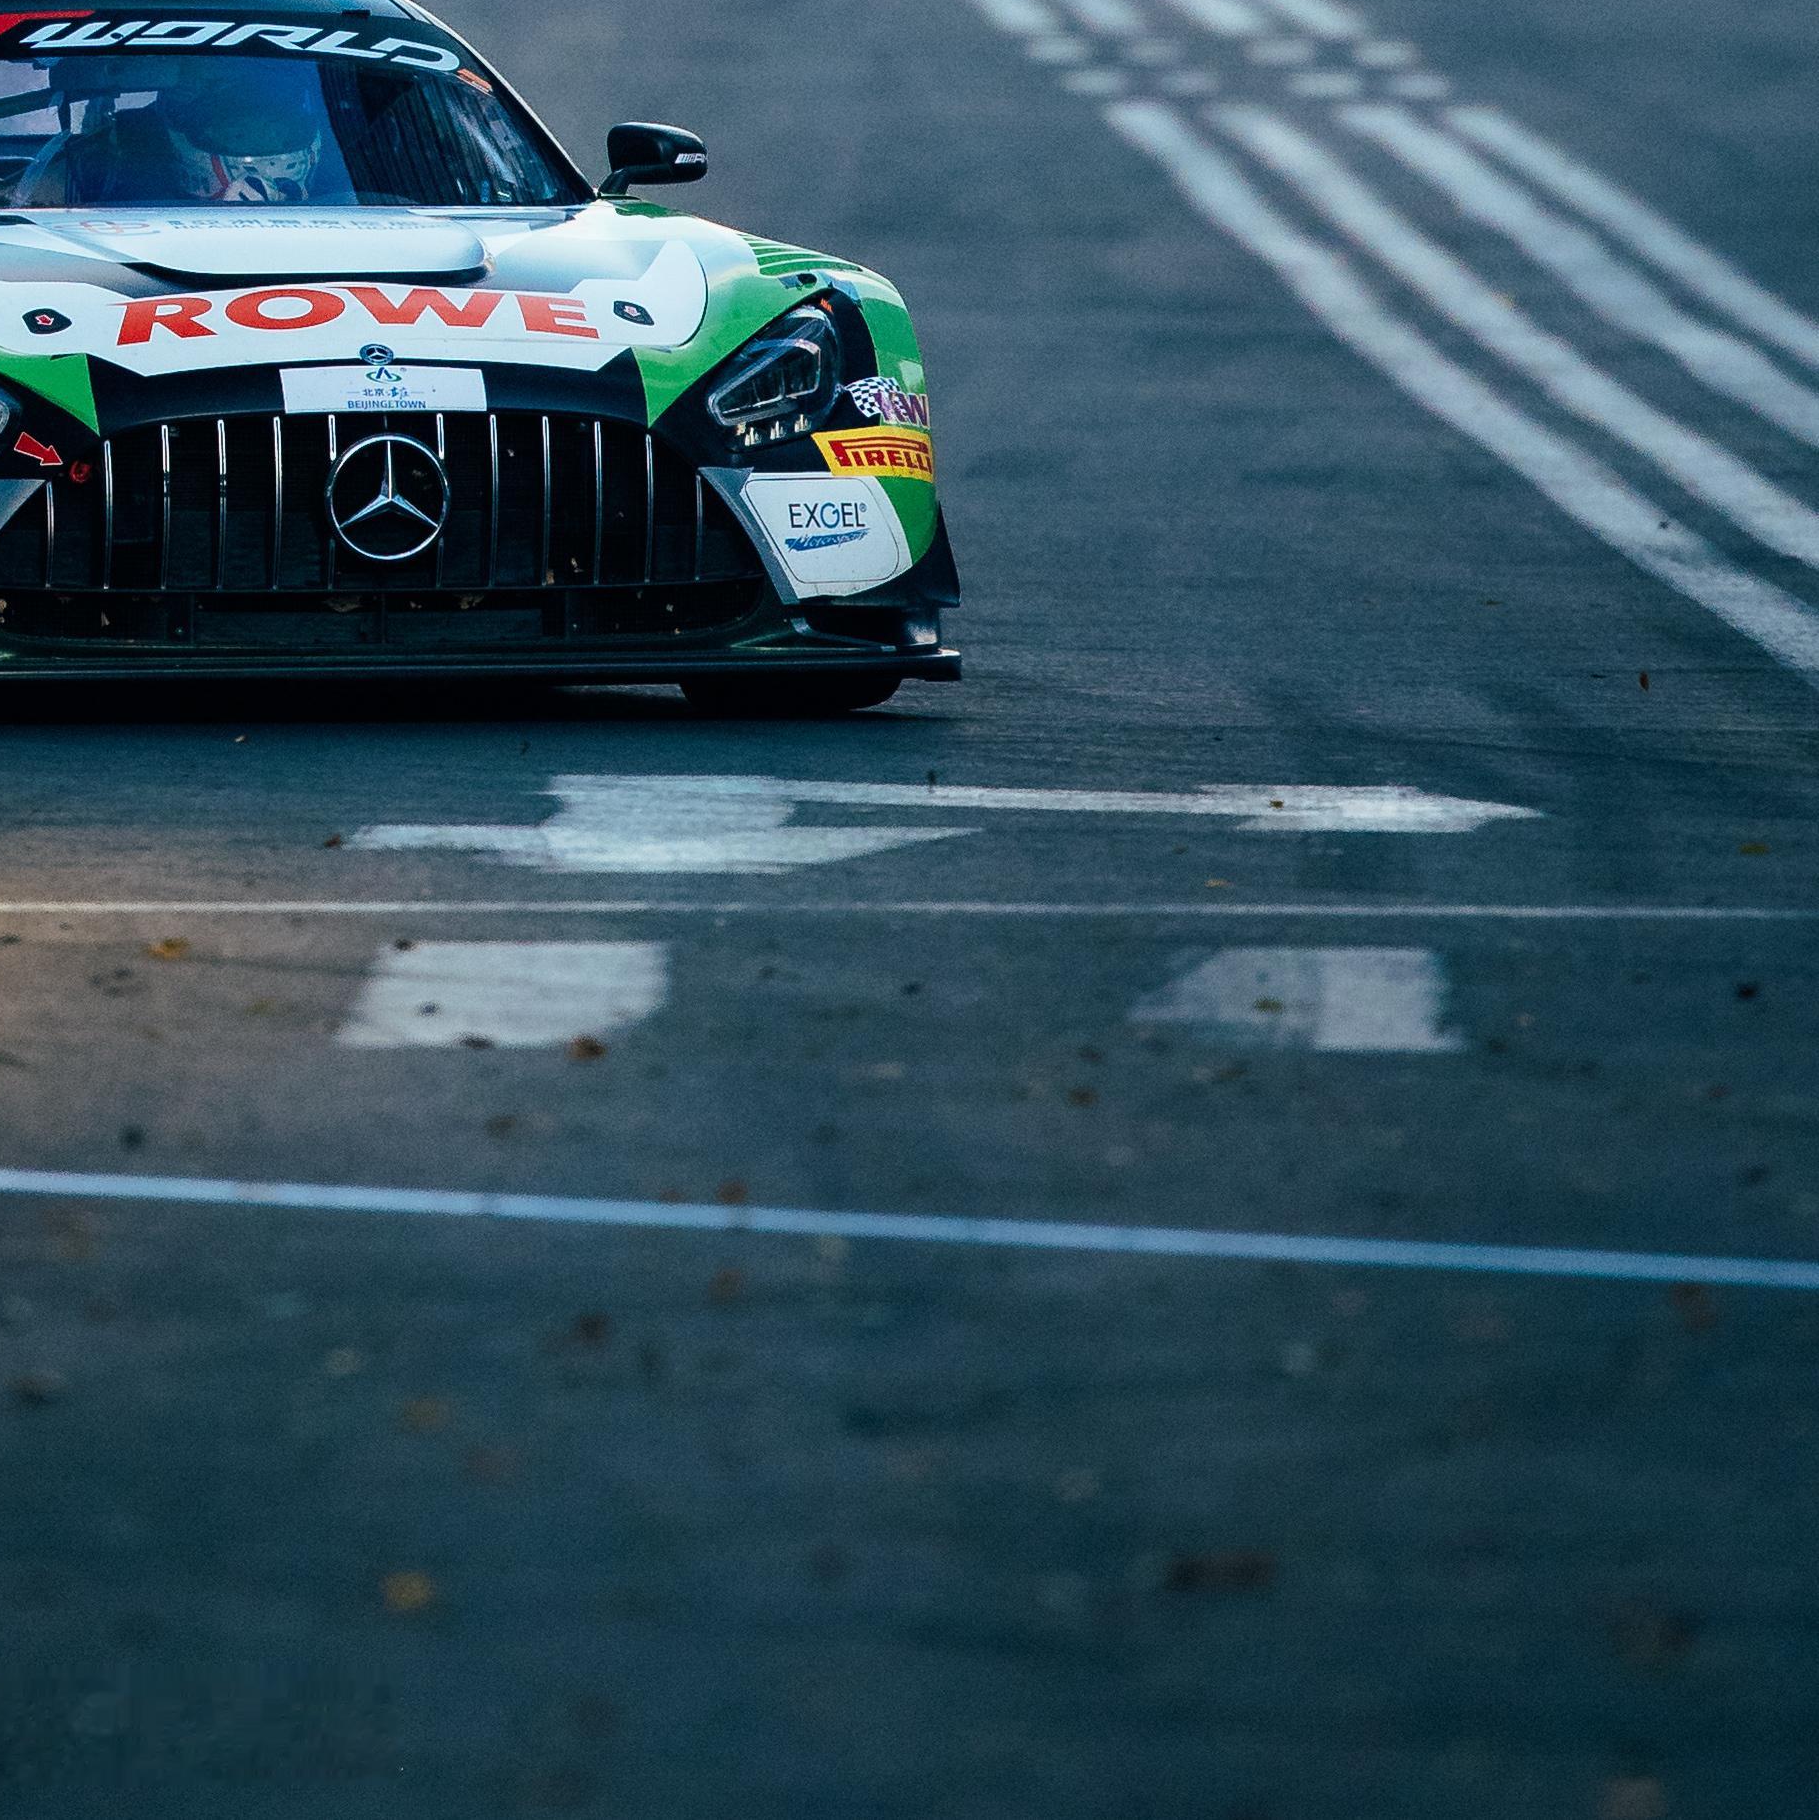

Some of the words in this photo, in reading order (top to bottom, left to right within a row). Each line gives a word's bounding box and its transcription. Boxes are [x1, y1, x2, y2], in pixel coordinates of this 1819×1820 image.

[19, 20, 461, 72] WORLD
[107, 286, 600, 346] ROWE
[874, 391, 931, 429] KW
